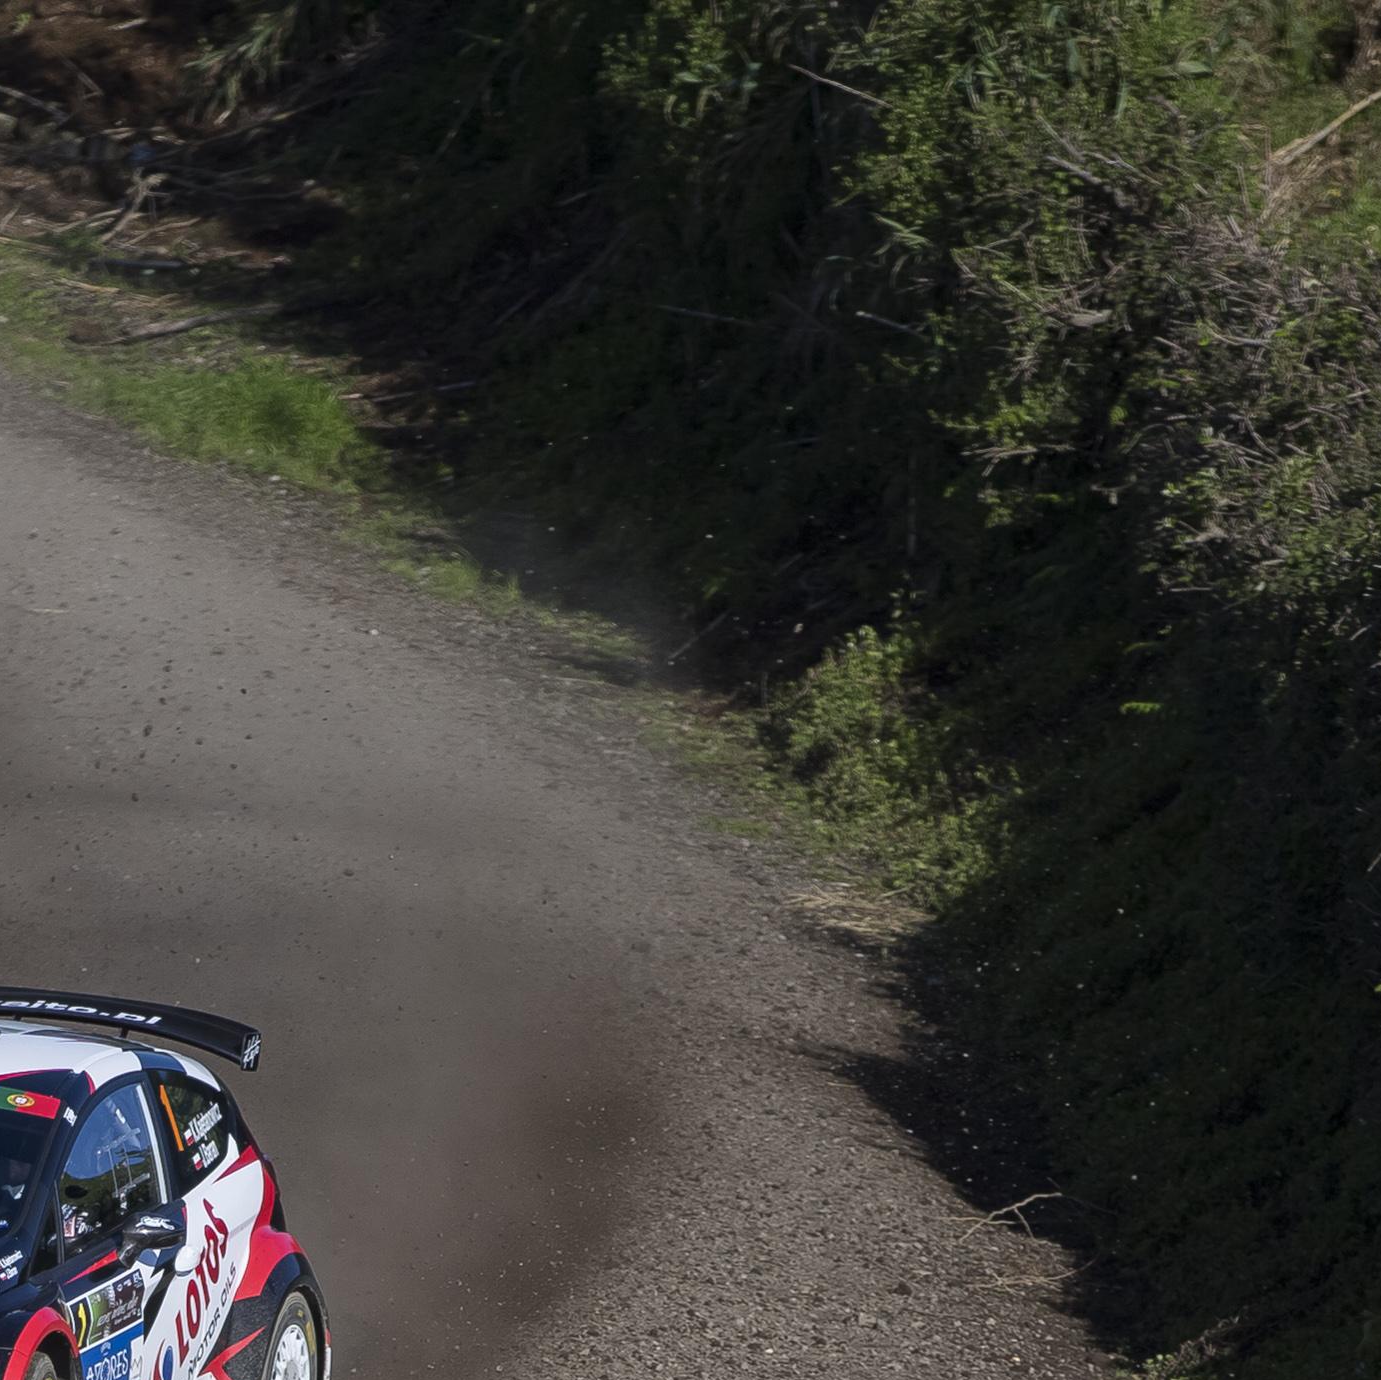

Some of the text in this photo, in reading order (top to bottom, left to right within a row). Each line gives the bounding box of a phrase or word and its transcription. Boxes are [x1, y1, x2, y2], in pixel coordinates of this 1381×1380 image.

[175, 1198, 229, 1368] LOTOS
[187, 1313, 221, 1380] MOTOR
[221, 1261, 238, 1308] OILS
